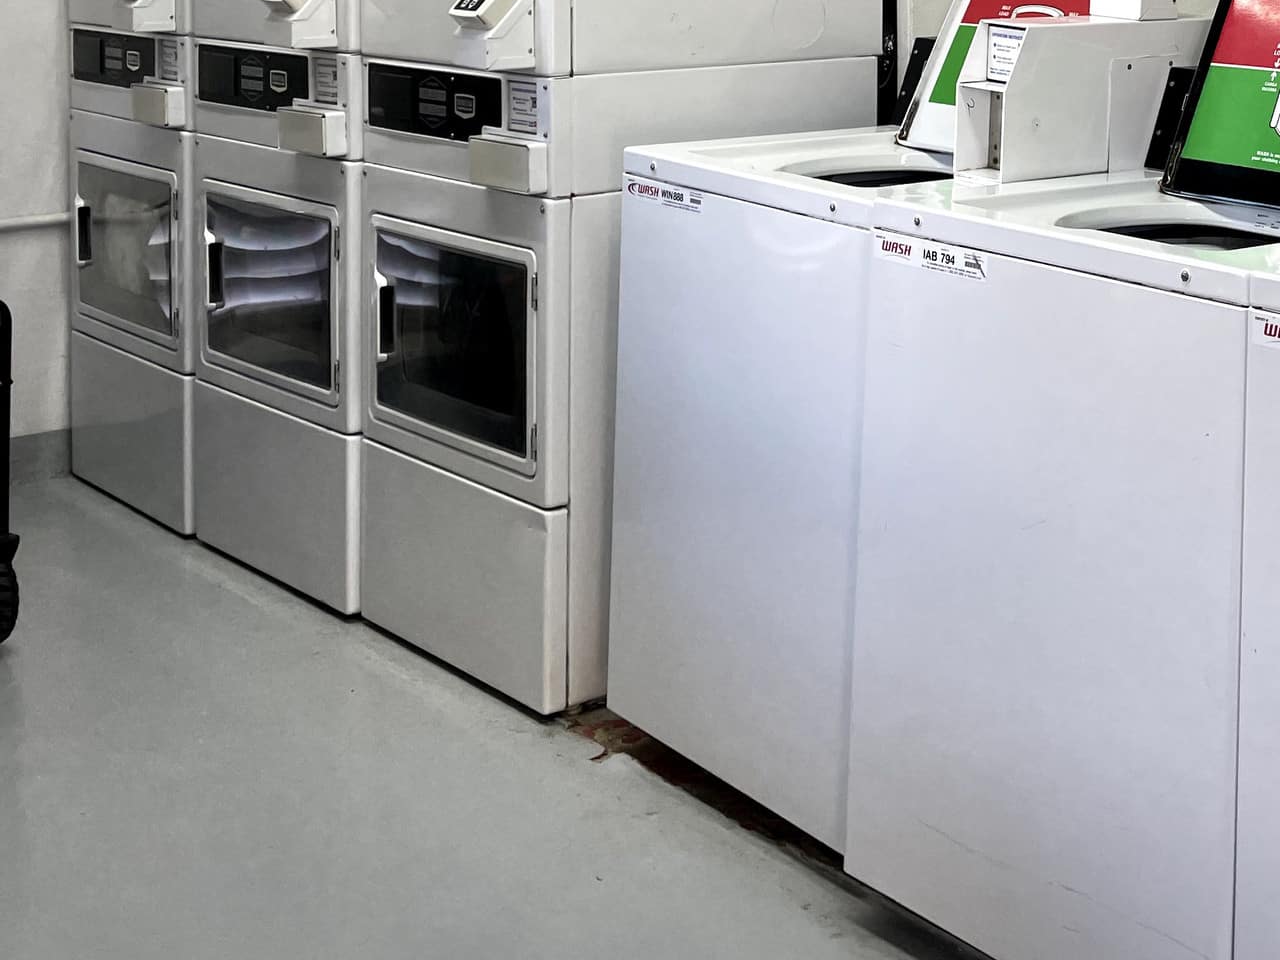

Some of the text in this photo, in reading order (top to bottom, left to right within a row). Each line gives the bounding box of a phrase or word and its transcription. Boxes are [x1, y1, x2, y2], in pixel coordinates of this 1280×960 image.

[638, 184, 659, 197] WASH
[882, 240, 955, 265] WASH IAB 794
